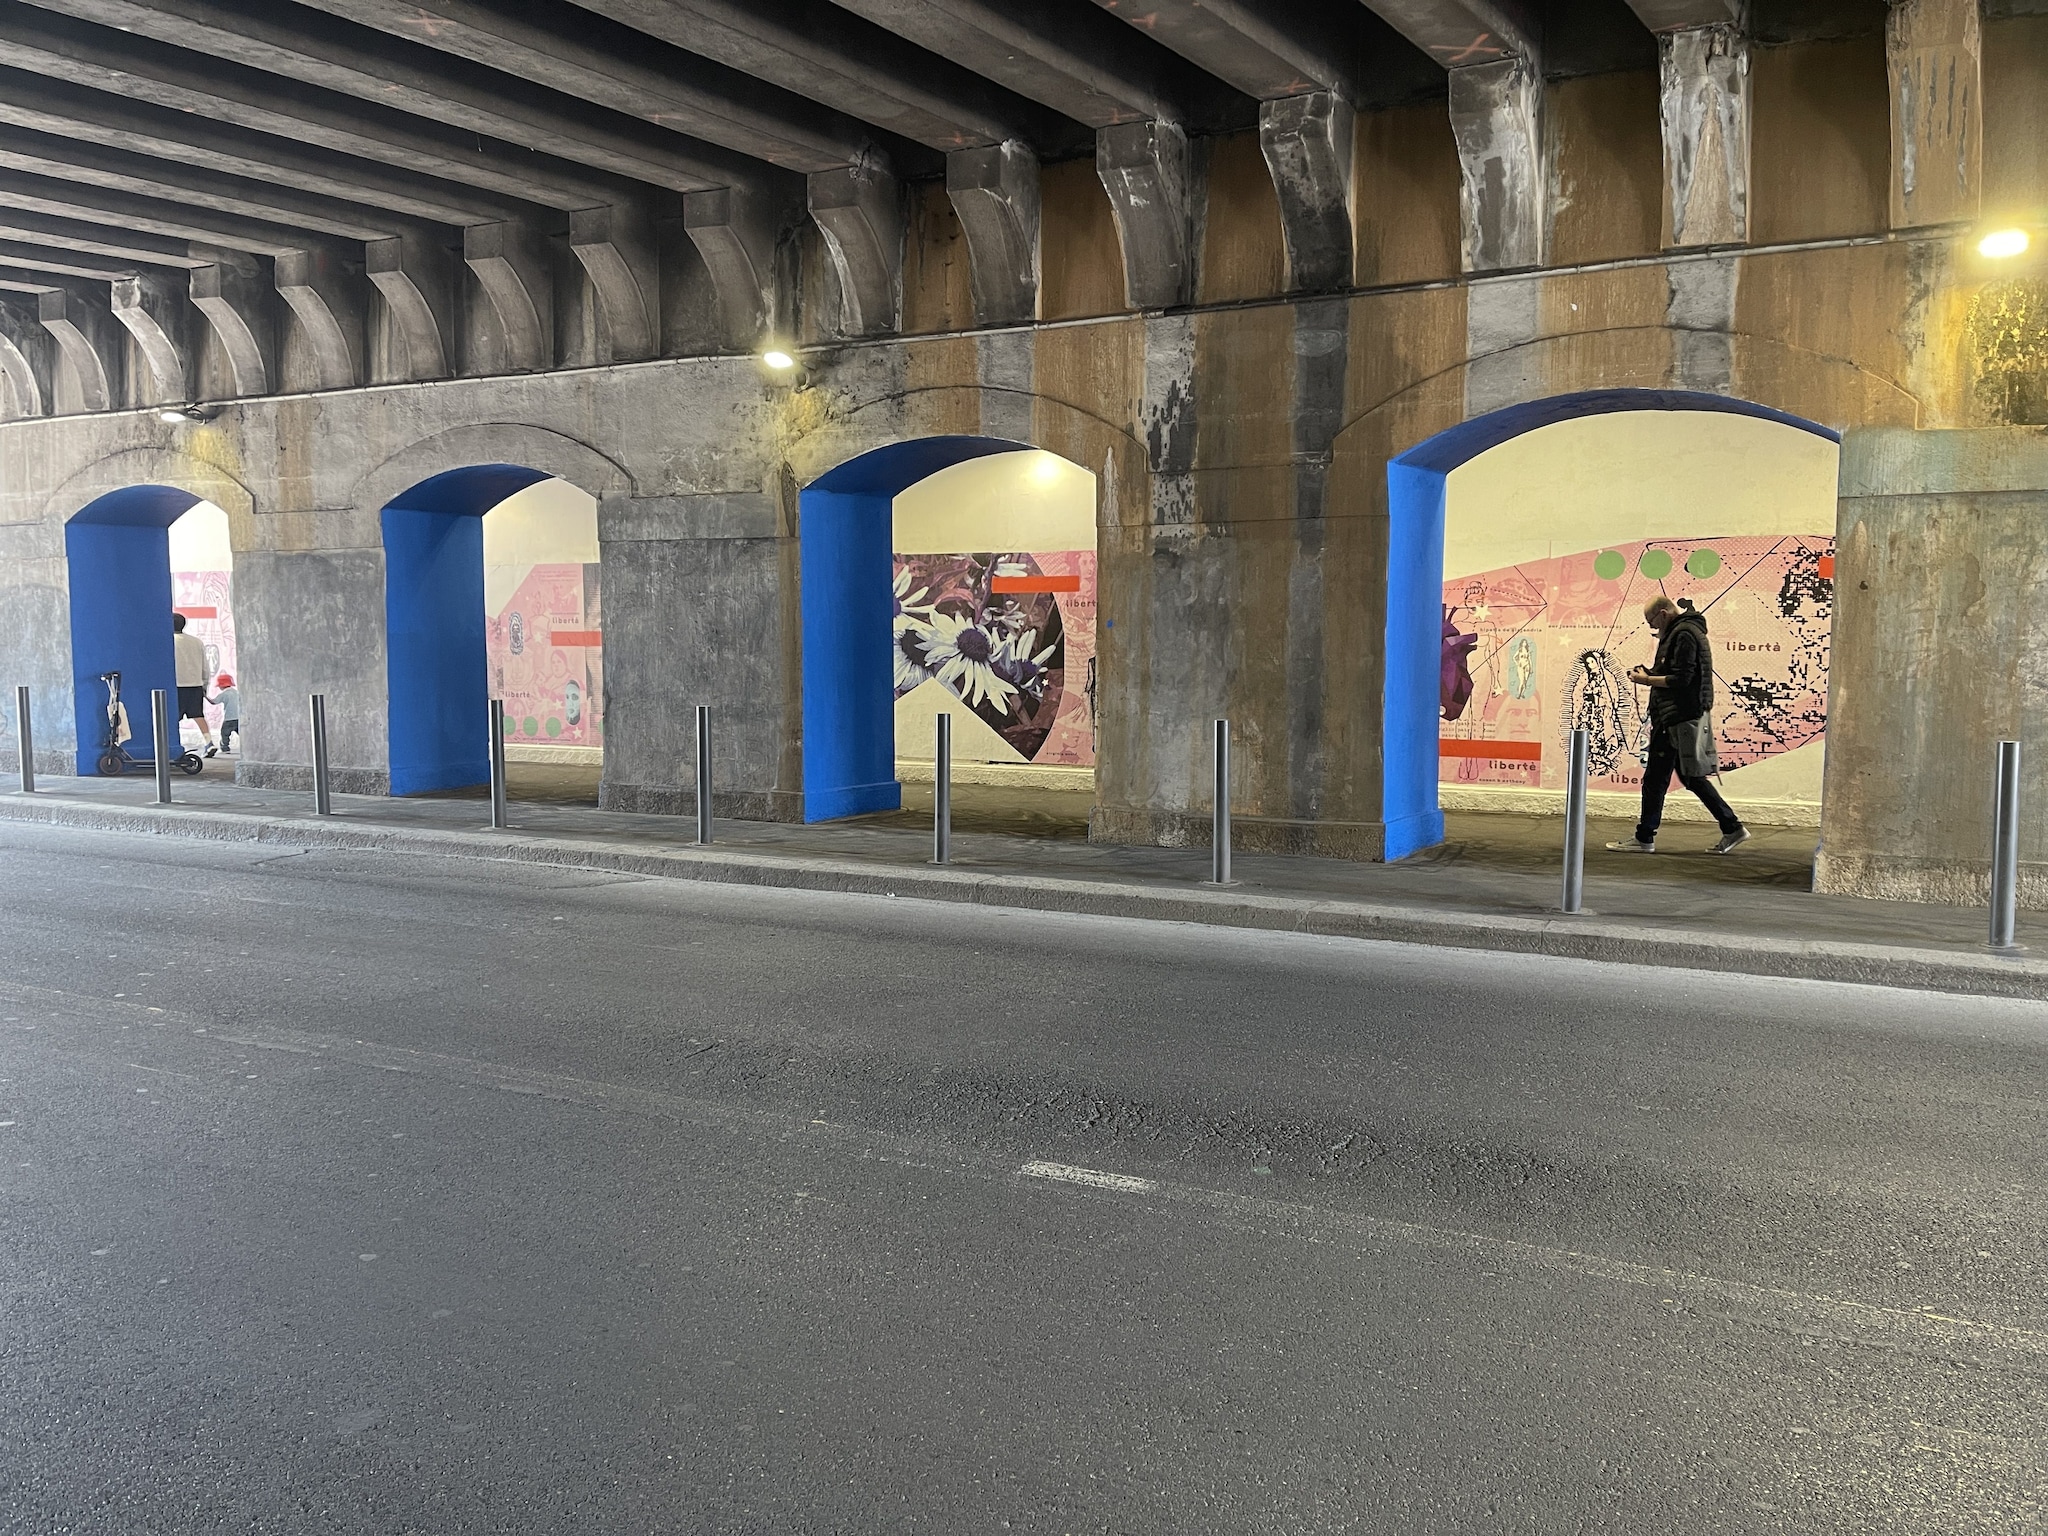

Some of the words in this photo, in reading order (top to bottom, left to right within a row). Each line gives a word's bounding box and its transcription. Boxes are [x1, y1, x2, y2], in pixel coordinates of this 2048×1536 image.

[1065, 599, 1096, 608] libert
[1726, 641, 1781, 652] libertà
[1610, 774, 1644, 785] liber
